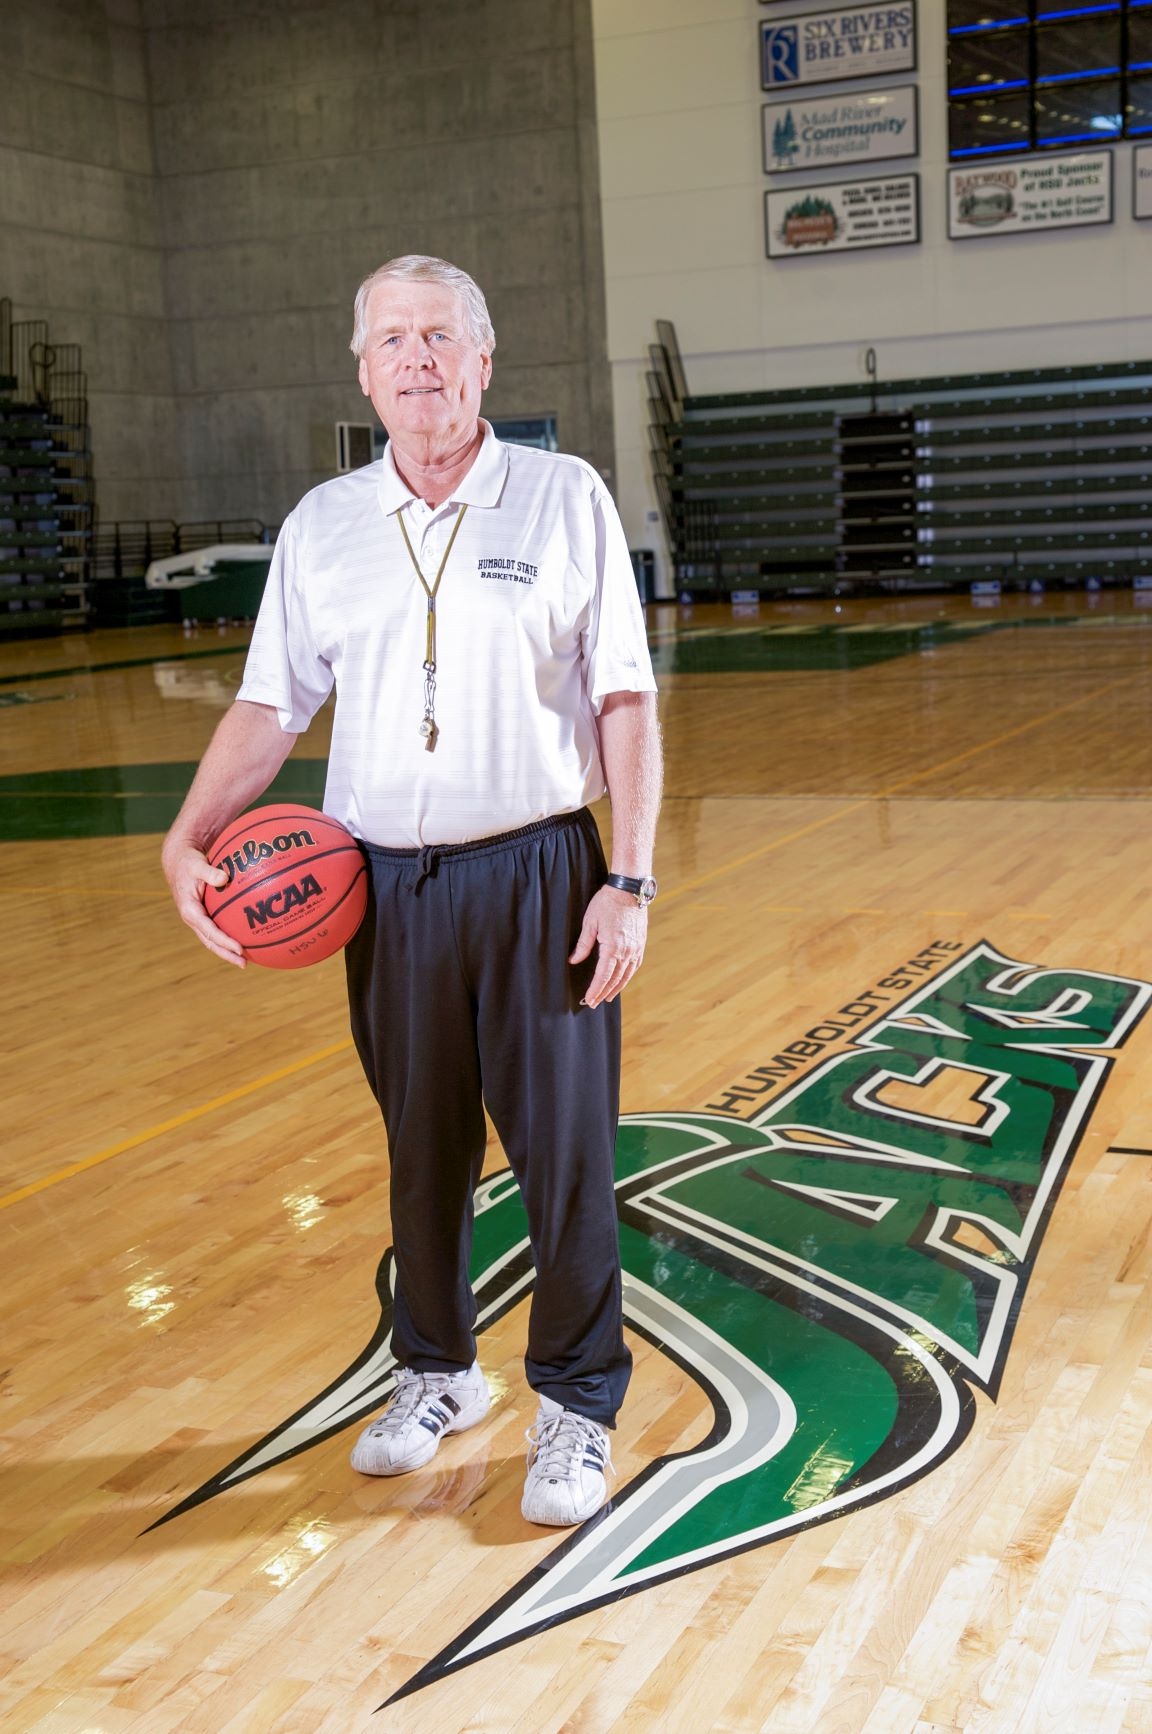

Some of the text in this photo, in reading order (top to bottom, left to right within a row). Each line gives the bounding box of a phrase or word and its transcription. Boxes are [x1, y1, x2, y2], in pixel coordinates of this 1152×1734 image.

[804, 7, 912, 41] SIX RIVERS
[804, 28, 913, 62] BREWERY
[801, 105, 883, 125] Mad River
[802, 115, 907, 142] Community
[804, 136, 871, 158] Hospital
[1020, 161, 1104, 179] Proud Sponsor
[478, 558, 538, 577] HUMBOLDT STATE
[480, 571, 534, 585] BASKETBALL
[243, 873, 323, 930] NCAA
[306, 897, 326, 909] BALL
[704, 939, 964, 1115] HUMBOLDT STATE
